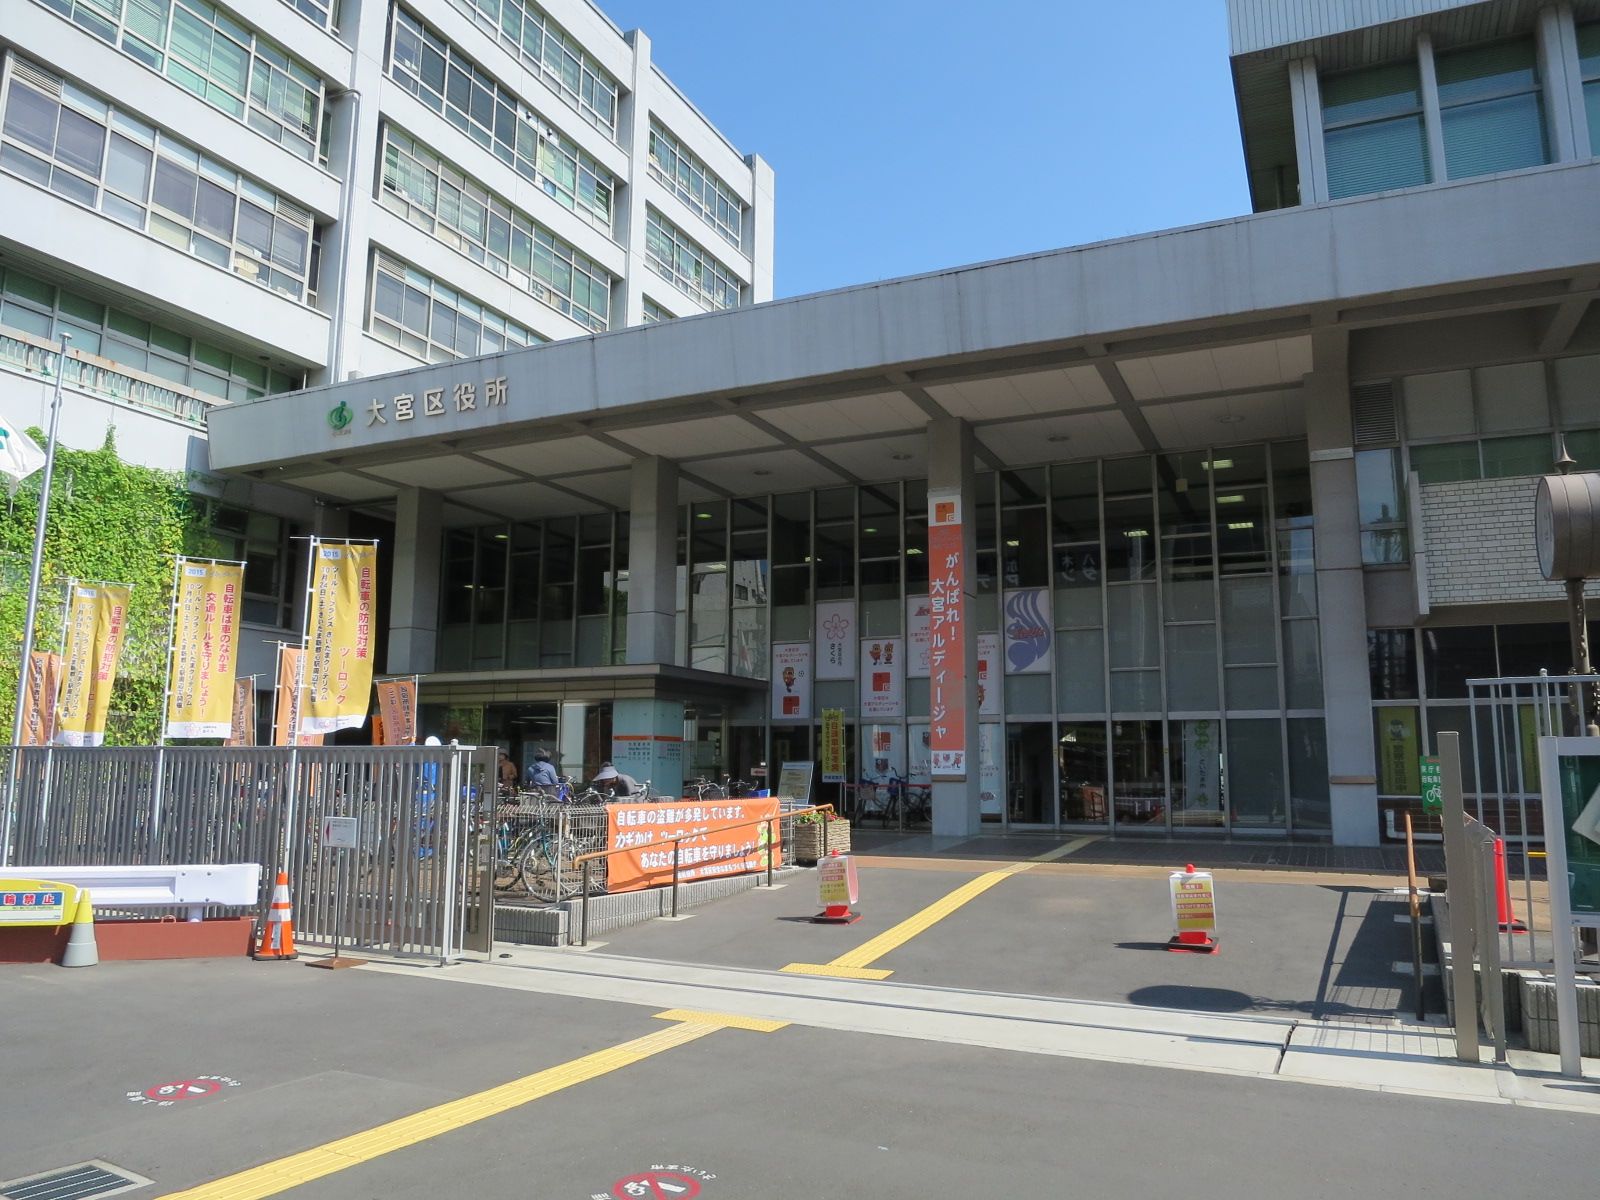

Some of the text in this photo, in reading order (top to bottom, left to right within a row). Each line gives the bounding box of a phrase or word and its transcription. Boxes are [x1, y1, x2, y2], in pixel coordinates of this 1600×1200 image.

[366, 376, 508, 427] 大宮区役所
[188, 568, 204, 576] 2015
[945, 552, 961, 641] がんばれ！
[97, 606, 122, 681] 自転車の防犯対策
[217, 584, 235, 673] 自転車は車のなかま
[356, 568, 371, 659] 自転車の防犯対策
[199, 592, 217, 717] 交通ルールを守りましょう！
[336, 647, 350, 704] ツーロック
[931, 578, 947, 739] 大宮アルディージャ
[615, 831, 654, 849] カギかけ
[616, 806, 744, 826] 自転車の盗難が多発しています。
